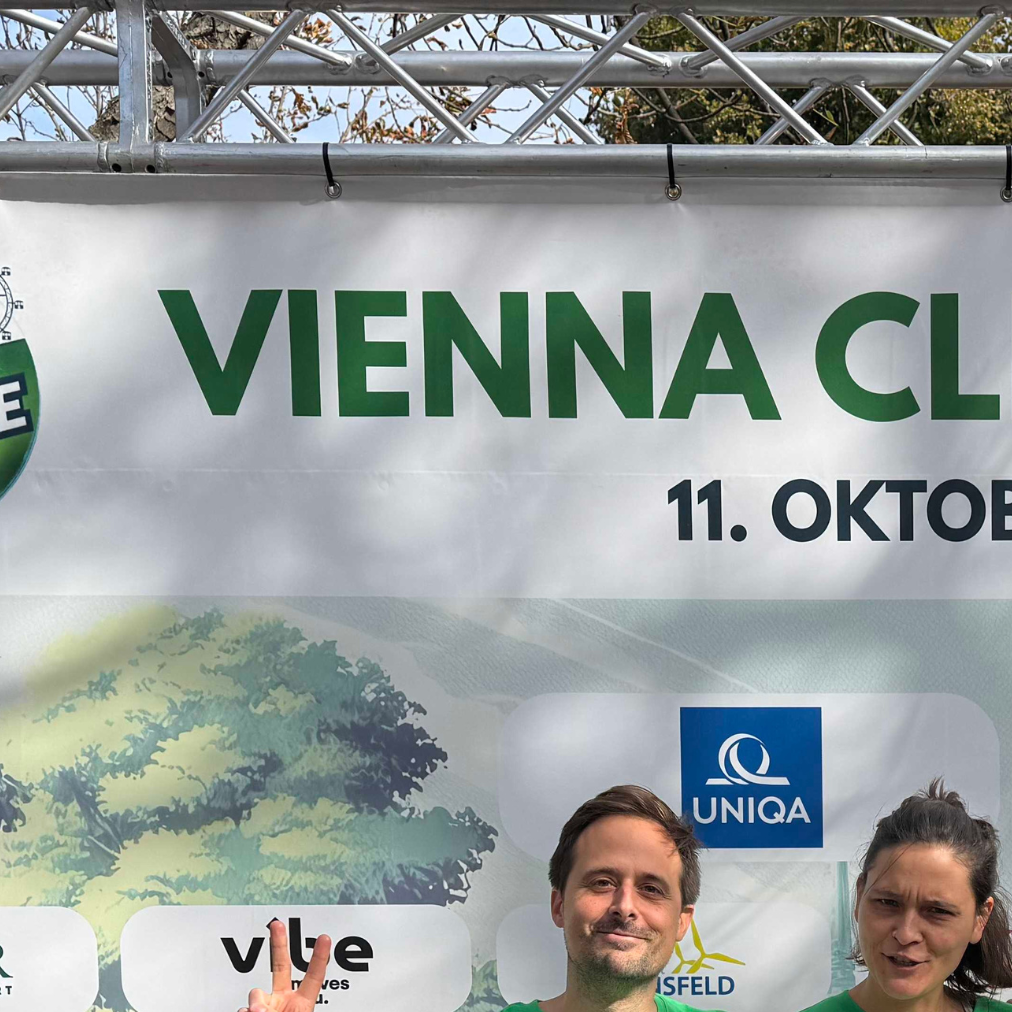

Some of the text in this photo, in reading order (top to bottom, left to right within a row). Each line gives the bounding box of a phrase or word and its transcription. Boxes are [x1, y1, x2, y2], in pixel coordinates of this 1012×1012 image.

[157, 289, 782, 420] VIENNA
[667, 478, 748, 542] 11.
[693, 796, 811, 824] UNIQA
